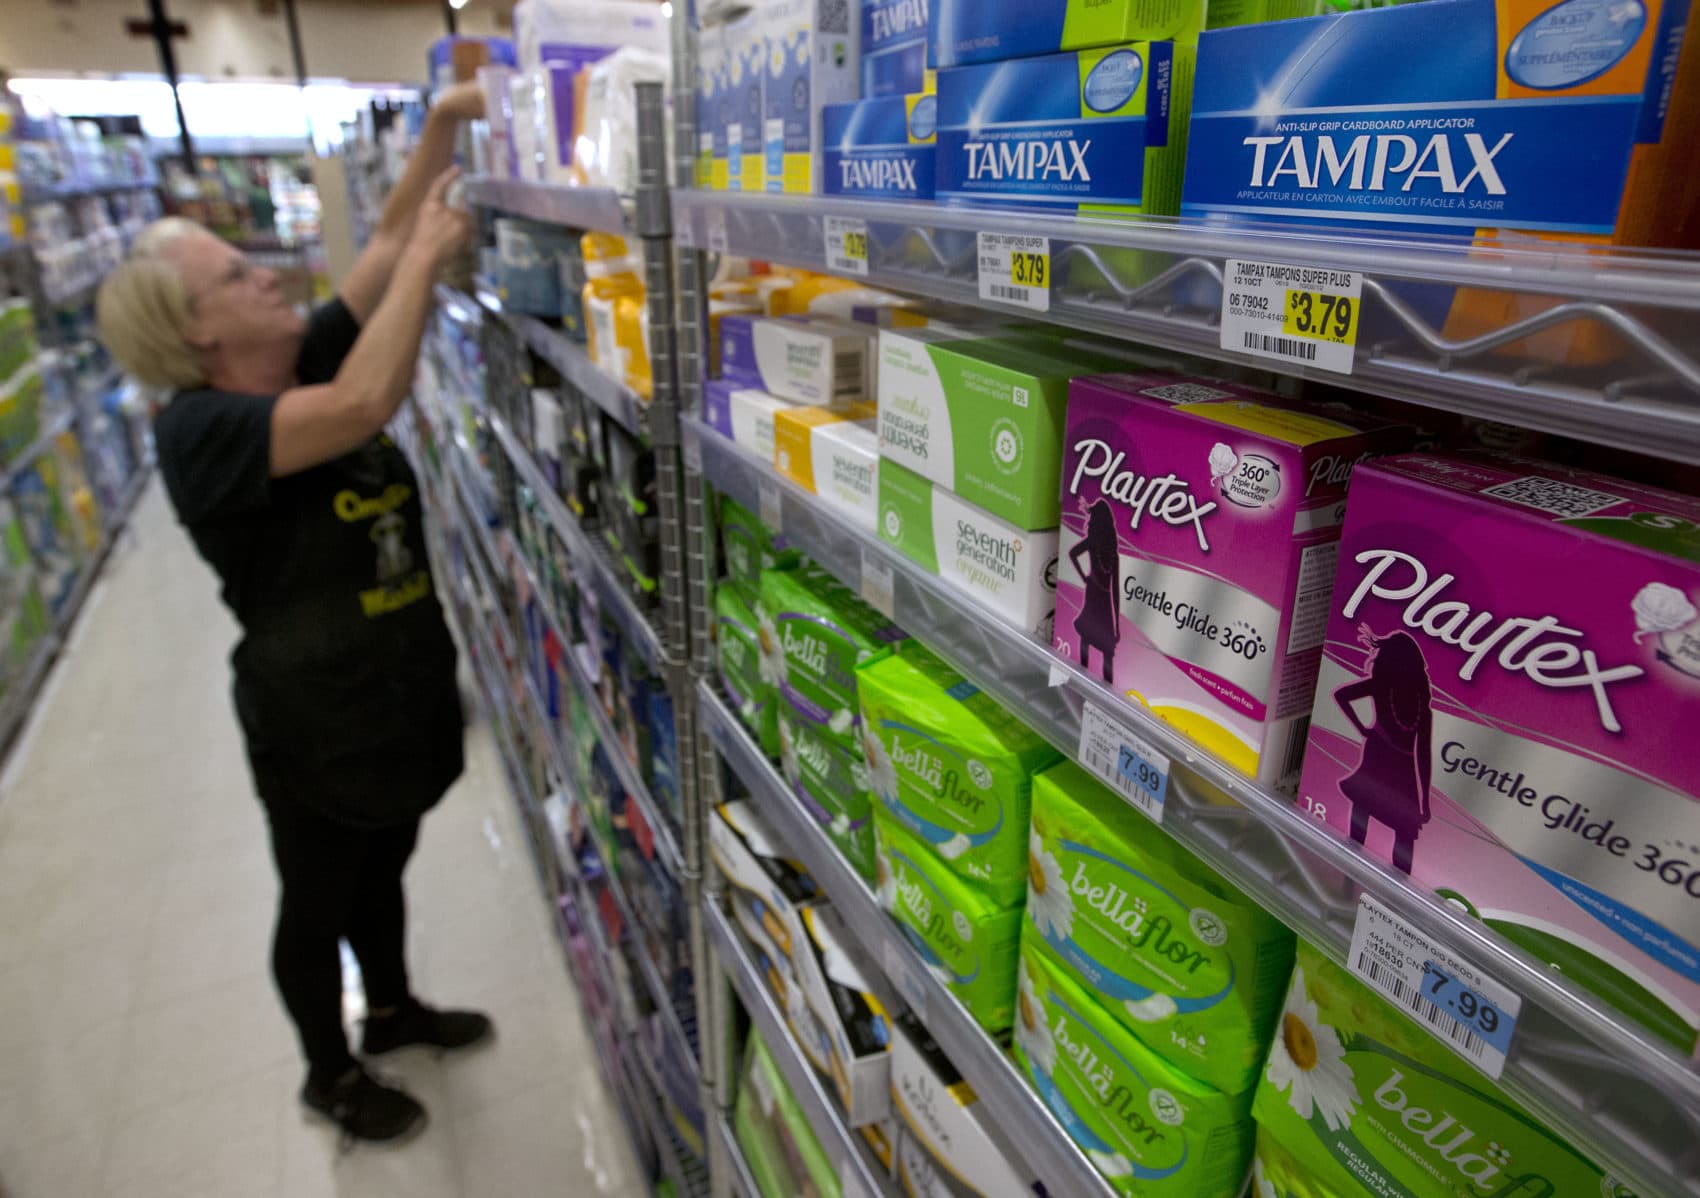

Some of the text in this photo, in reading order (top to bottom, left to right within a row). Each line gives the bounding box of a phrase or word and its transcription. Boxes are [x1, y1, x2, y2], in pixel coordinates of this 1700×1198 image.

[871, 0, 928, 42] TAMPA
[1275, 118, 1475, 133] ANTI-SLIP GRIP CARDBOARD APPLICATOR
[838, 159, 917, 191] TAMPAX
[963, 139, 1092, 182] TAMPAX
[1243, 133, 1514, 195] TAMPAX
[1236, 191, 1505, 211] APPLICATEUR EN CARTON AVEC EMBOUT FACILE À SAISIR
[1233, 276, 1262, 287] 12 10CT
[1236, 262, 1265, 278] TAMPAX
[1266, 265, 1301, 282] TAMPONS
[1302, 269, 1329, 286] SUPER
[1329, 271, 1351, 288] PLUS
[1229, 293, 1269, 310] 06 79042
[1291, 291, 1352, 338] $3.79
[1230, 484, 1266, 503] Protection
[1232, 475, 1270, 495] Triple Layer
[1239, 462, 1271, 482] 360°
[1070, 438, 1217, 551] Playtex
[956, 539, 1015, 582] generation
[957, 519, 1016, 568] seventh
[1123, 575, 1172, 616] Gentle
[1174, 602, 1218, 641] Glide
[1342, 549, 1645, 733] Playtex
[1441, 741, 1537, 807] Gentle
[1541, 794, 1631, 856] Glide
[1127, 915, 1212, 975] flor
[1360, 899, 1393, 925] PLAYTEX
[1395, 922, 1429, 950] TAMPON
[1385, 942, 1405, 959] PER
[1422, 961, 1499, 1033] $7.99
[1337, 1141, 1388, 1187] REGULAR
[1346, 1160, 1390, 1198] REGULAR
